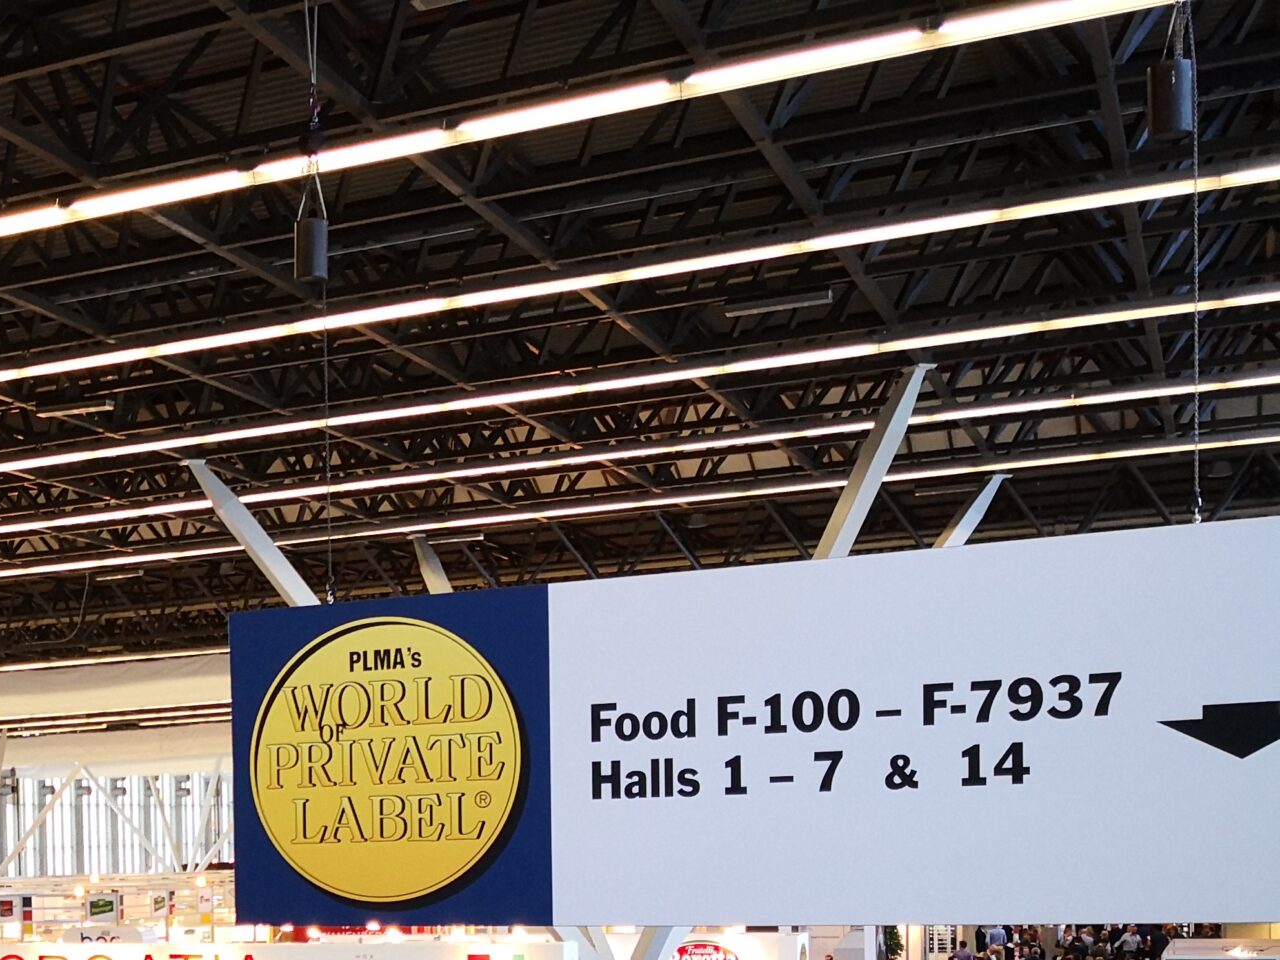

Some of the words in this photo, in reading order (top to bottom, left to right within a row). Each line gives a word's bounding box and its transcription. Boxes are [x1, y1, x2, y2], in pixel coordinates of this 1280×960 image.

[349, 647, 422, 672] PLMA's
[282, 674, 493, 732] WORLD
[590, 698, 697, 742] Food
[717, 688, 860, 736] F-100
[923, 671, 1122, 726] F-7937
[267, 731, 505, 790] PRIVATE
[320, 723, 345, 744] OF
[591, 758, 701, 800] Halls
[724, 755, 748, 795] 1
[813, 750, 844, 793] 7
[884, 754, 919, 790] &
[961, 741, 1031, 787] 14
